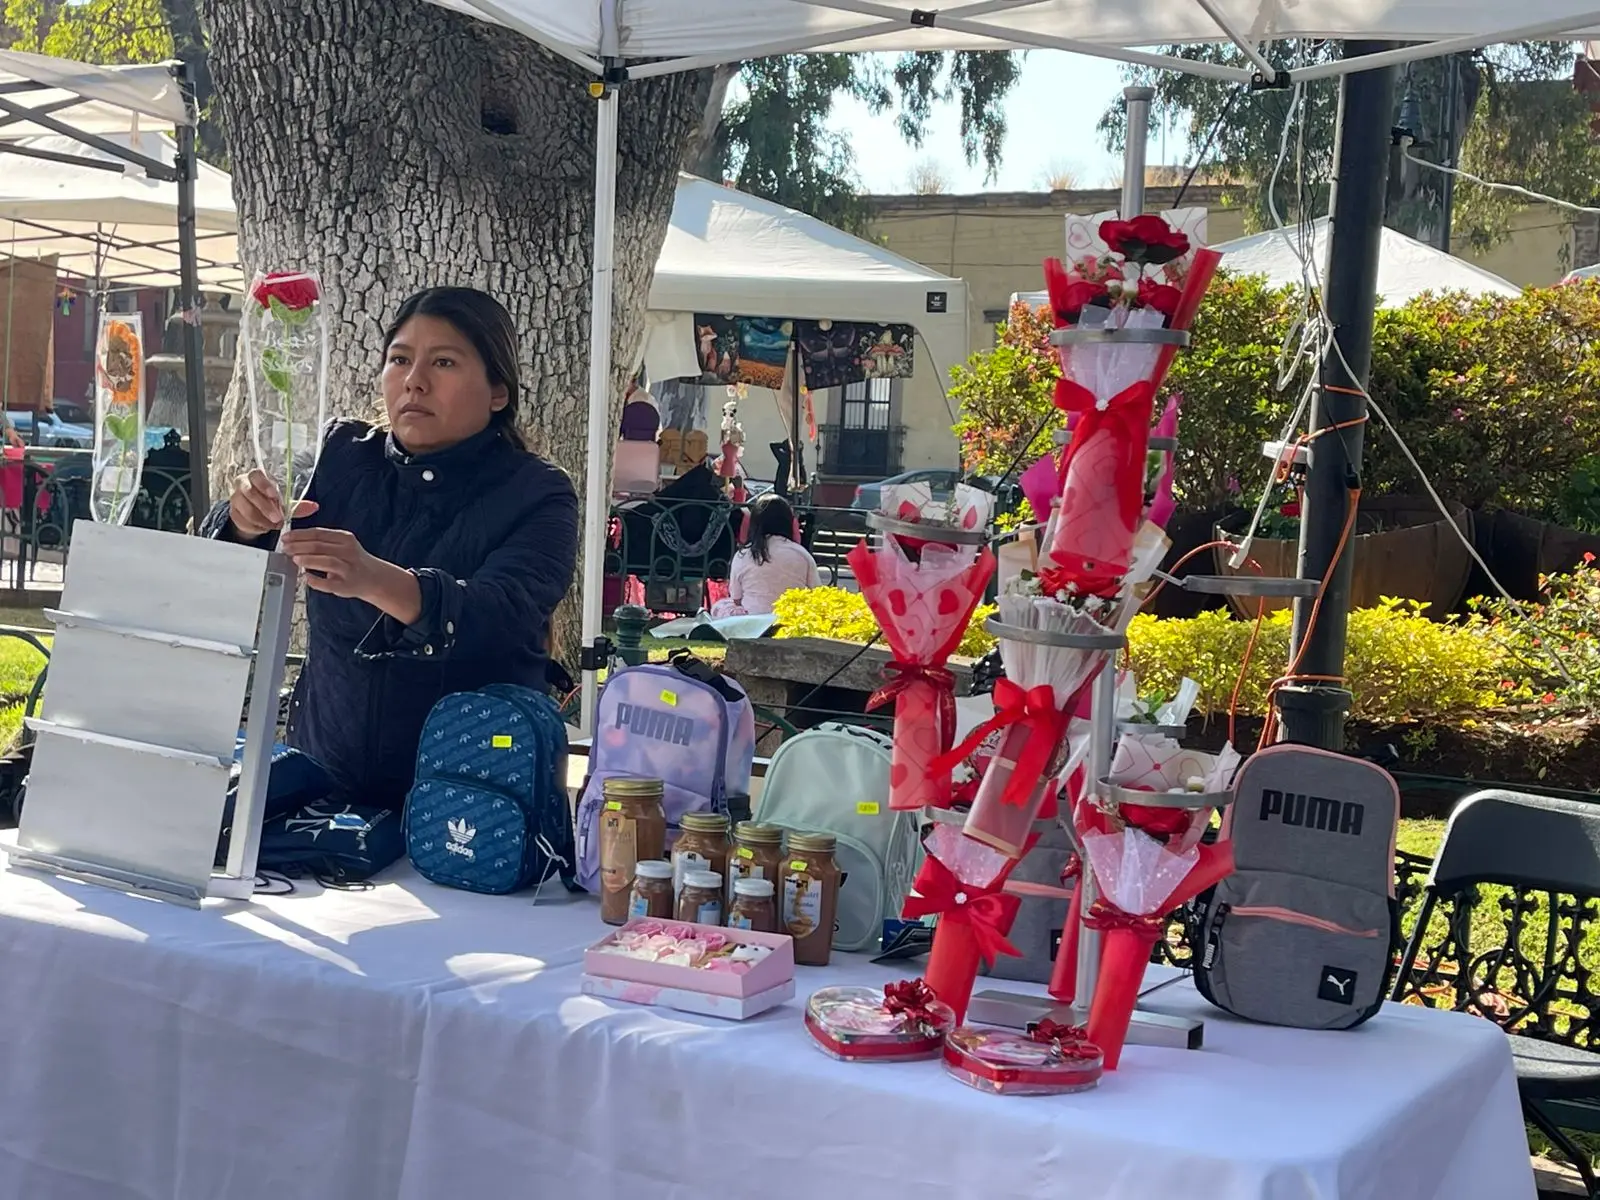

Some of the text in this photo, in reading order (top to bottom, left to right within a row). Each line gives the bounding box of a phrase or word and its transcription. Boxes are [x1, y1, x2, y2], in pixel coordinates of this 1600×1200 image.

[615, 702, 694, 747] PUMA
[1260, 788, 1365, 836] PUMA
[445, 841, 474, 857] adidas
